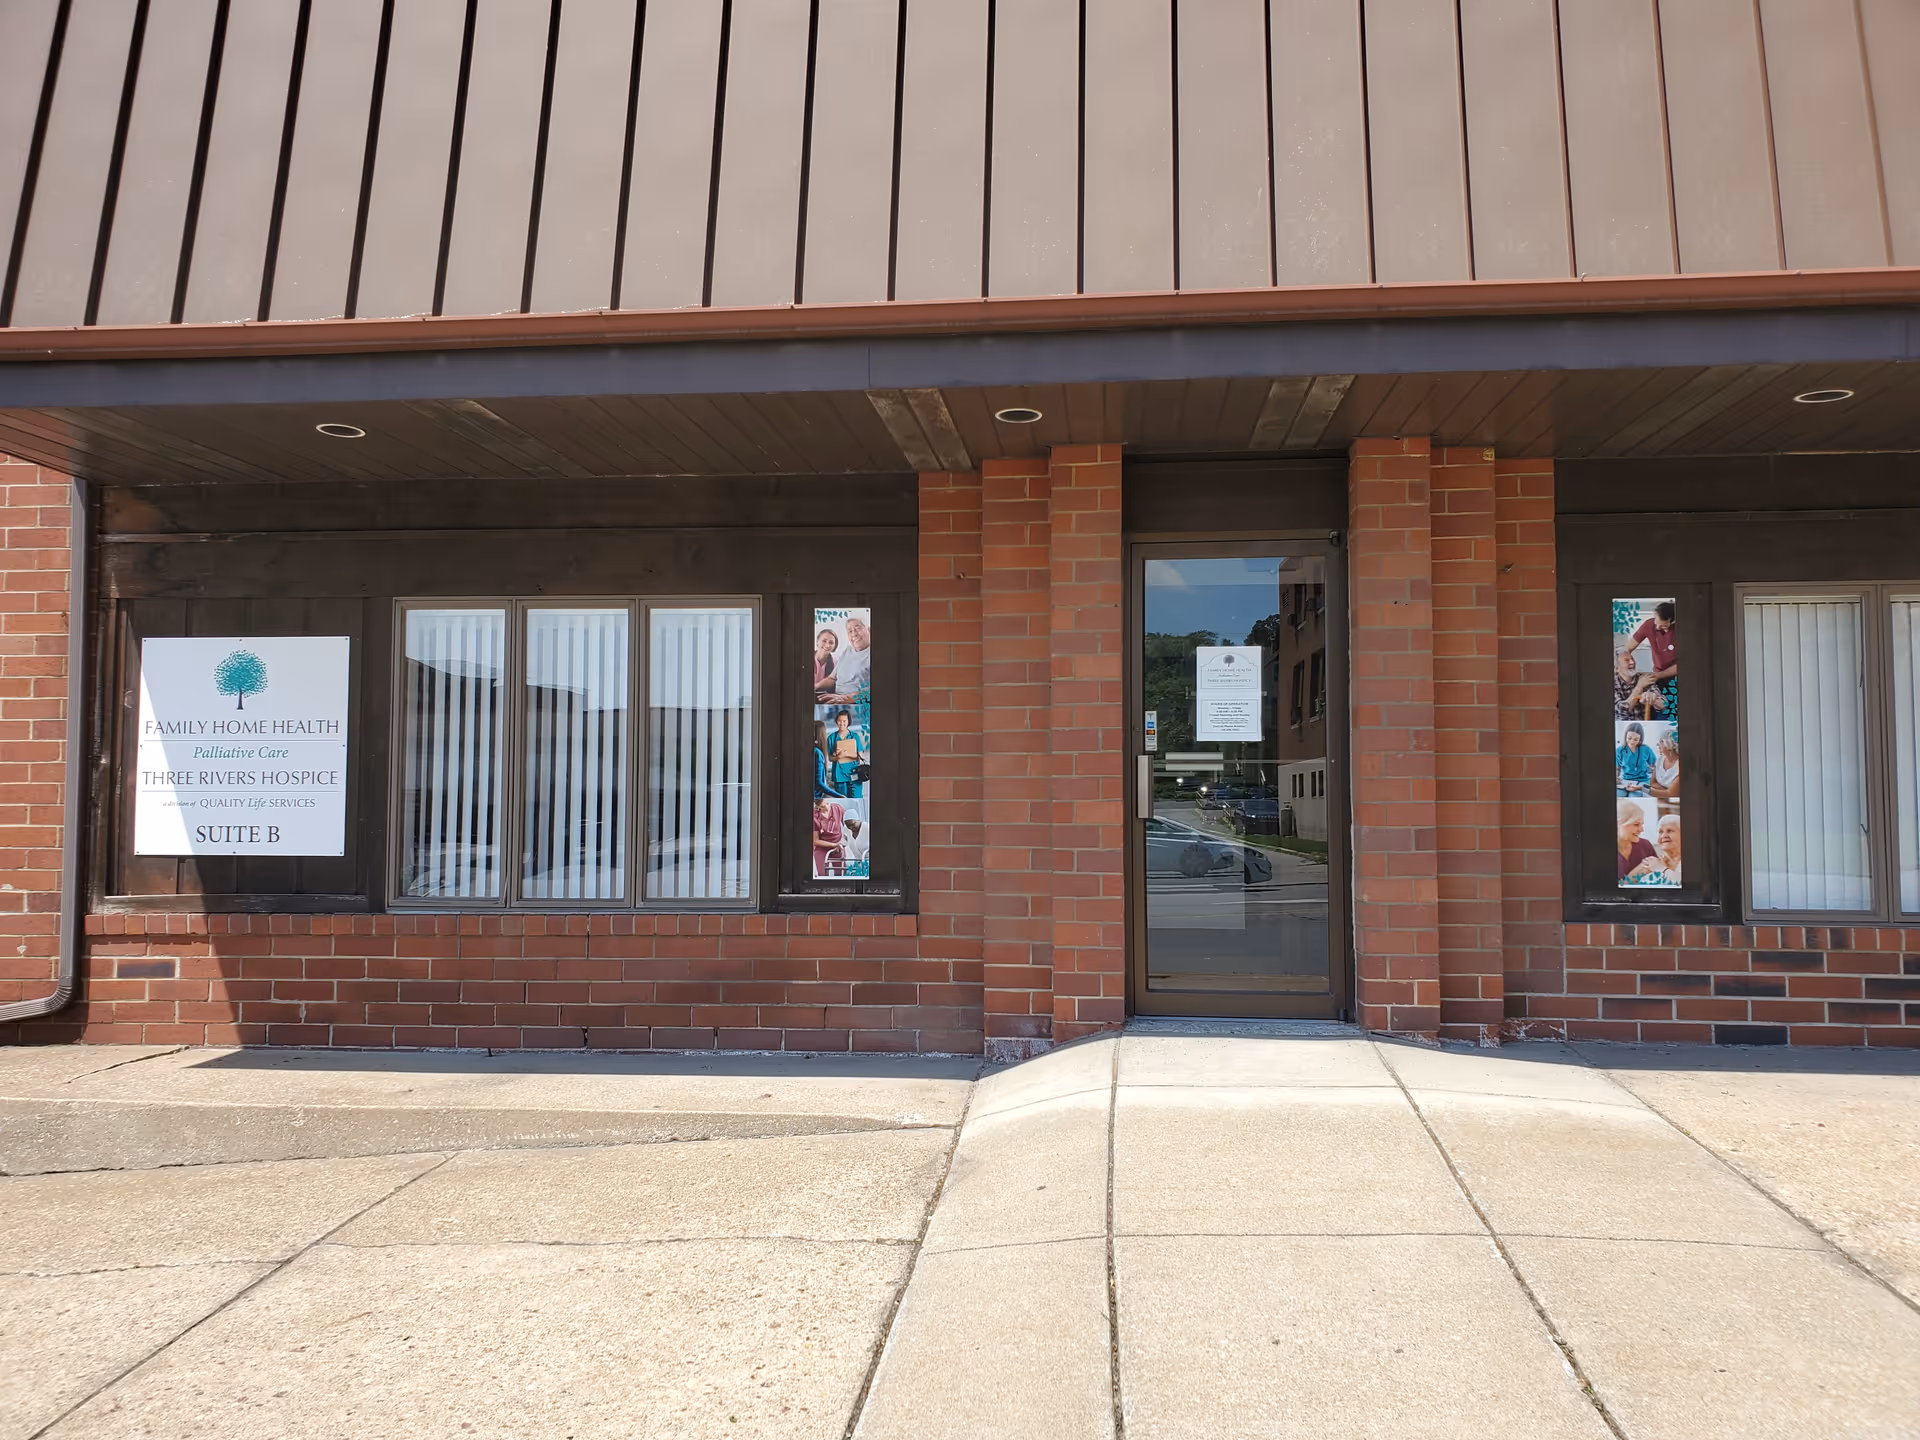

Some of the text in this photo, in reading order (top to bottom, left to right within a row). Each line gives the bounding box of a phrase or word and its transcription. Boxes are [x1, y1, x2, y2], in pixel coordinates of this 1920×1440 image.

[145, 720, 339, 734] FAMILY HOME HEALTH
[193, 746, 288, 758] Palliative Care
[142, 771, 338, 785] THREE RIVERS HOSPICE
[200, 799, 245, 808] QUALITY
[248, 798, 266, 810] Life
[269, 799, 315, 808] SERVICES
[196, 825, 280, 843] SUITE B
